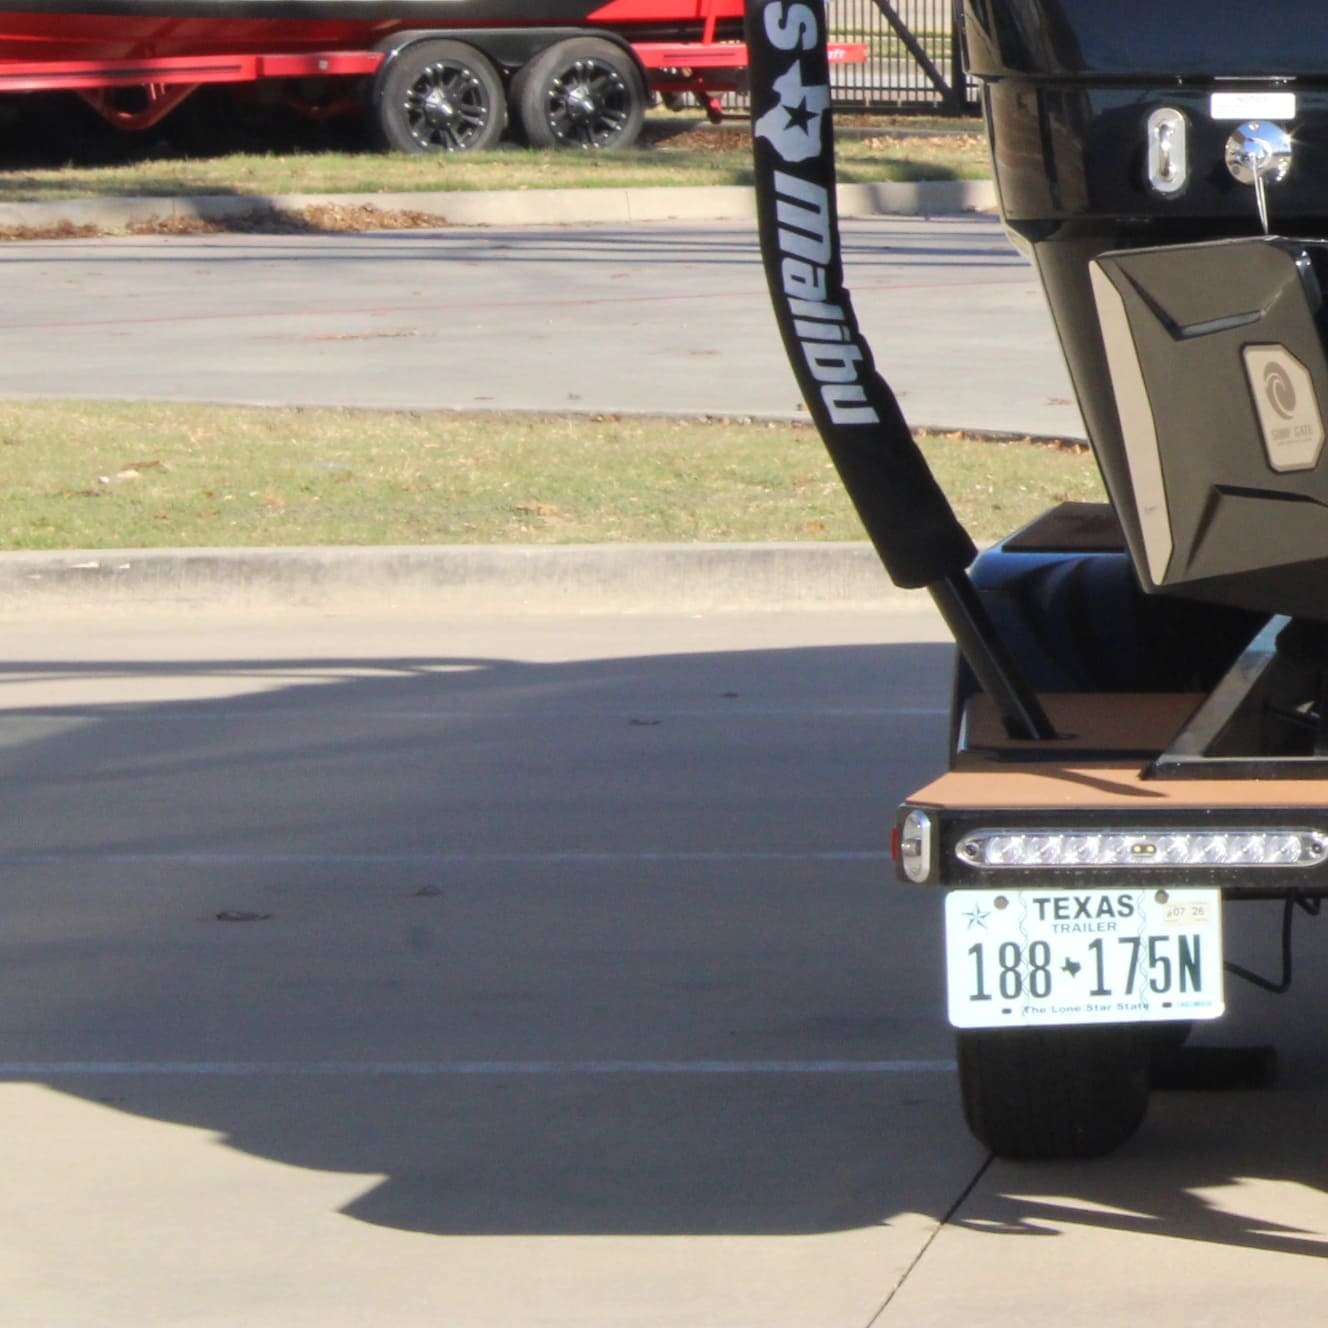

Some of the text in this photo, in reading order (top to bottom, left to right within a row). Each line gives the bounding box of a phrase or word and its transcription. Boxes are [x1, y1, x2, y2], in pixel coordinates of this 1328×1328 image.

[1033, 894, 1135, 921] TEXAS
[1052, 922, 1117, 934] TRAILER
[967, 933, 1202, 1002] 188 175N
[1024, 1002, 1149, 1015] The Lone Star State
